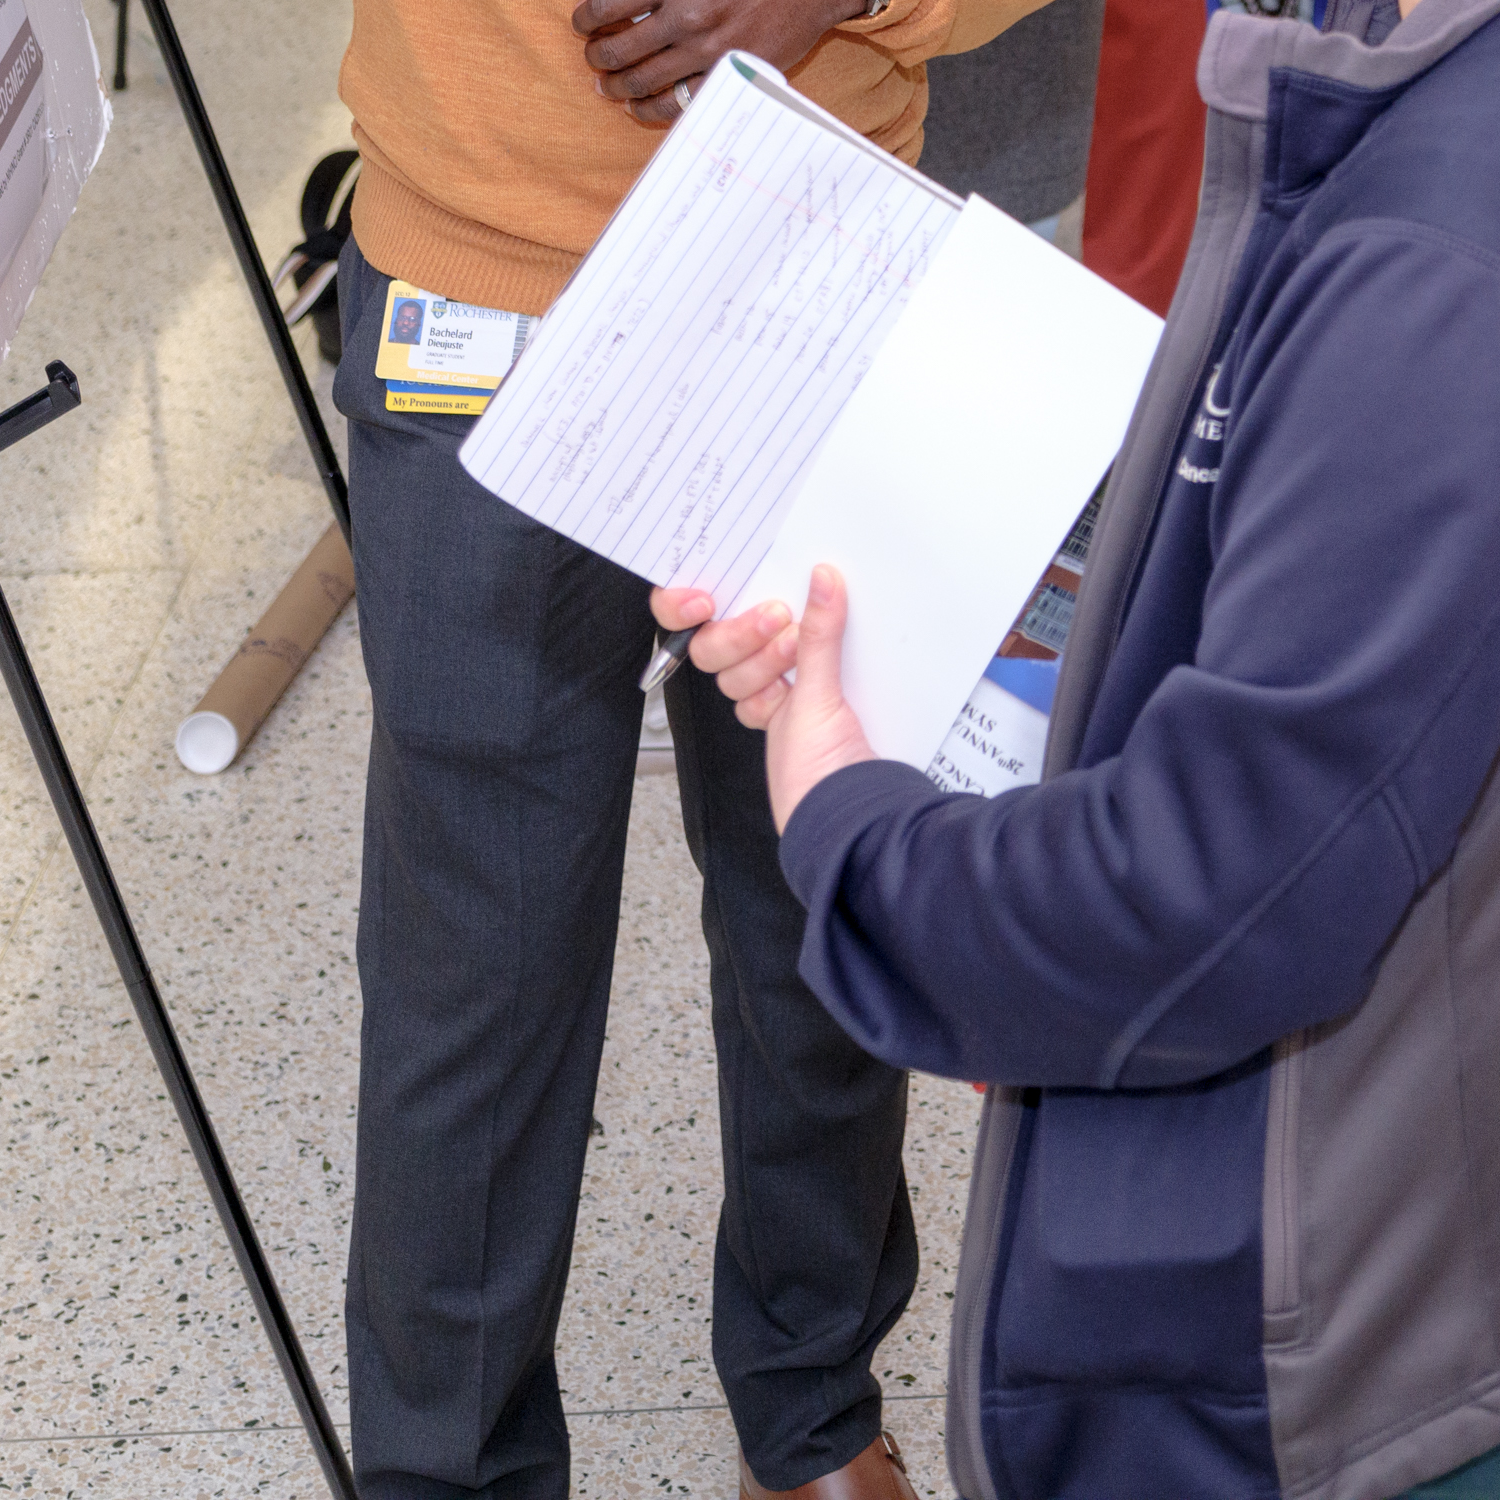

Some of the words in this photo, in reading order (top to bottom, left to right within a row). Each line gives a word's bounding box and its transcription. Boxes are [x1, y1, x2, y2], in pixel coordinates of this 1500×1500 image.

[450, 303, 512, 322] ROCHESTER
[429, 327, 473, 340] Bachelard
[427, 338, 464, 350] Dieujuste
[417, 370, 450, 382] Medical
[450, 374, 479, 385] Center
[393, 397, 407, 407] My
[409, 398, 453, 409] Pronouns
[455, 401, 469, 409] are
